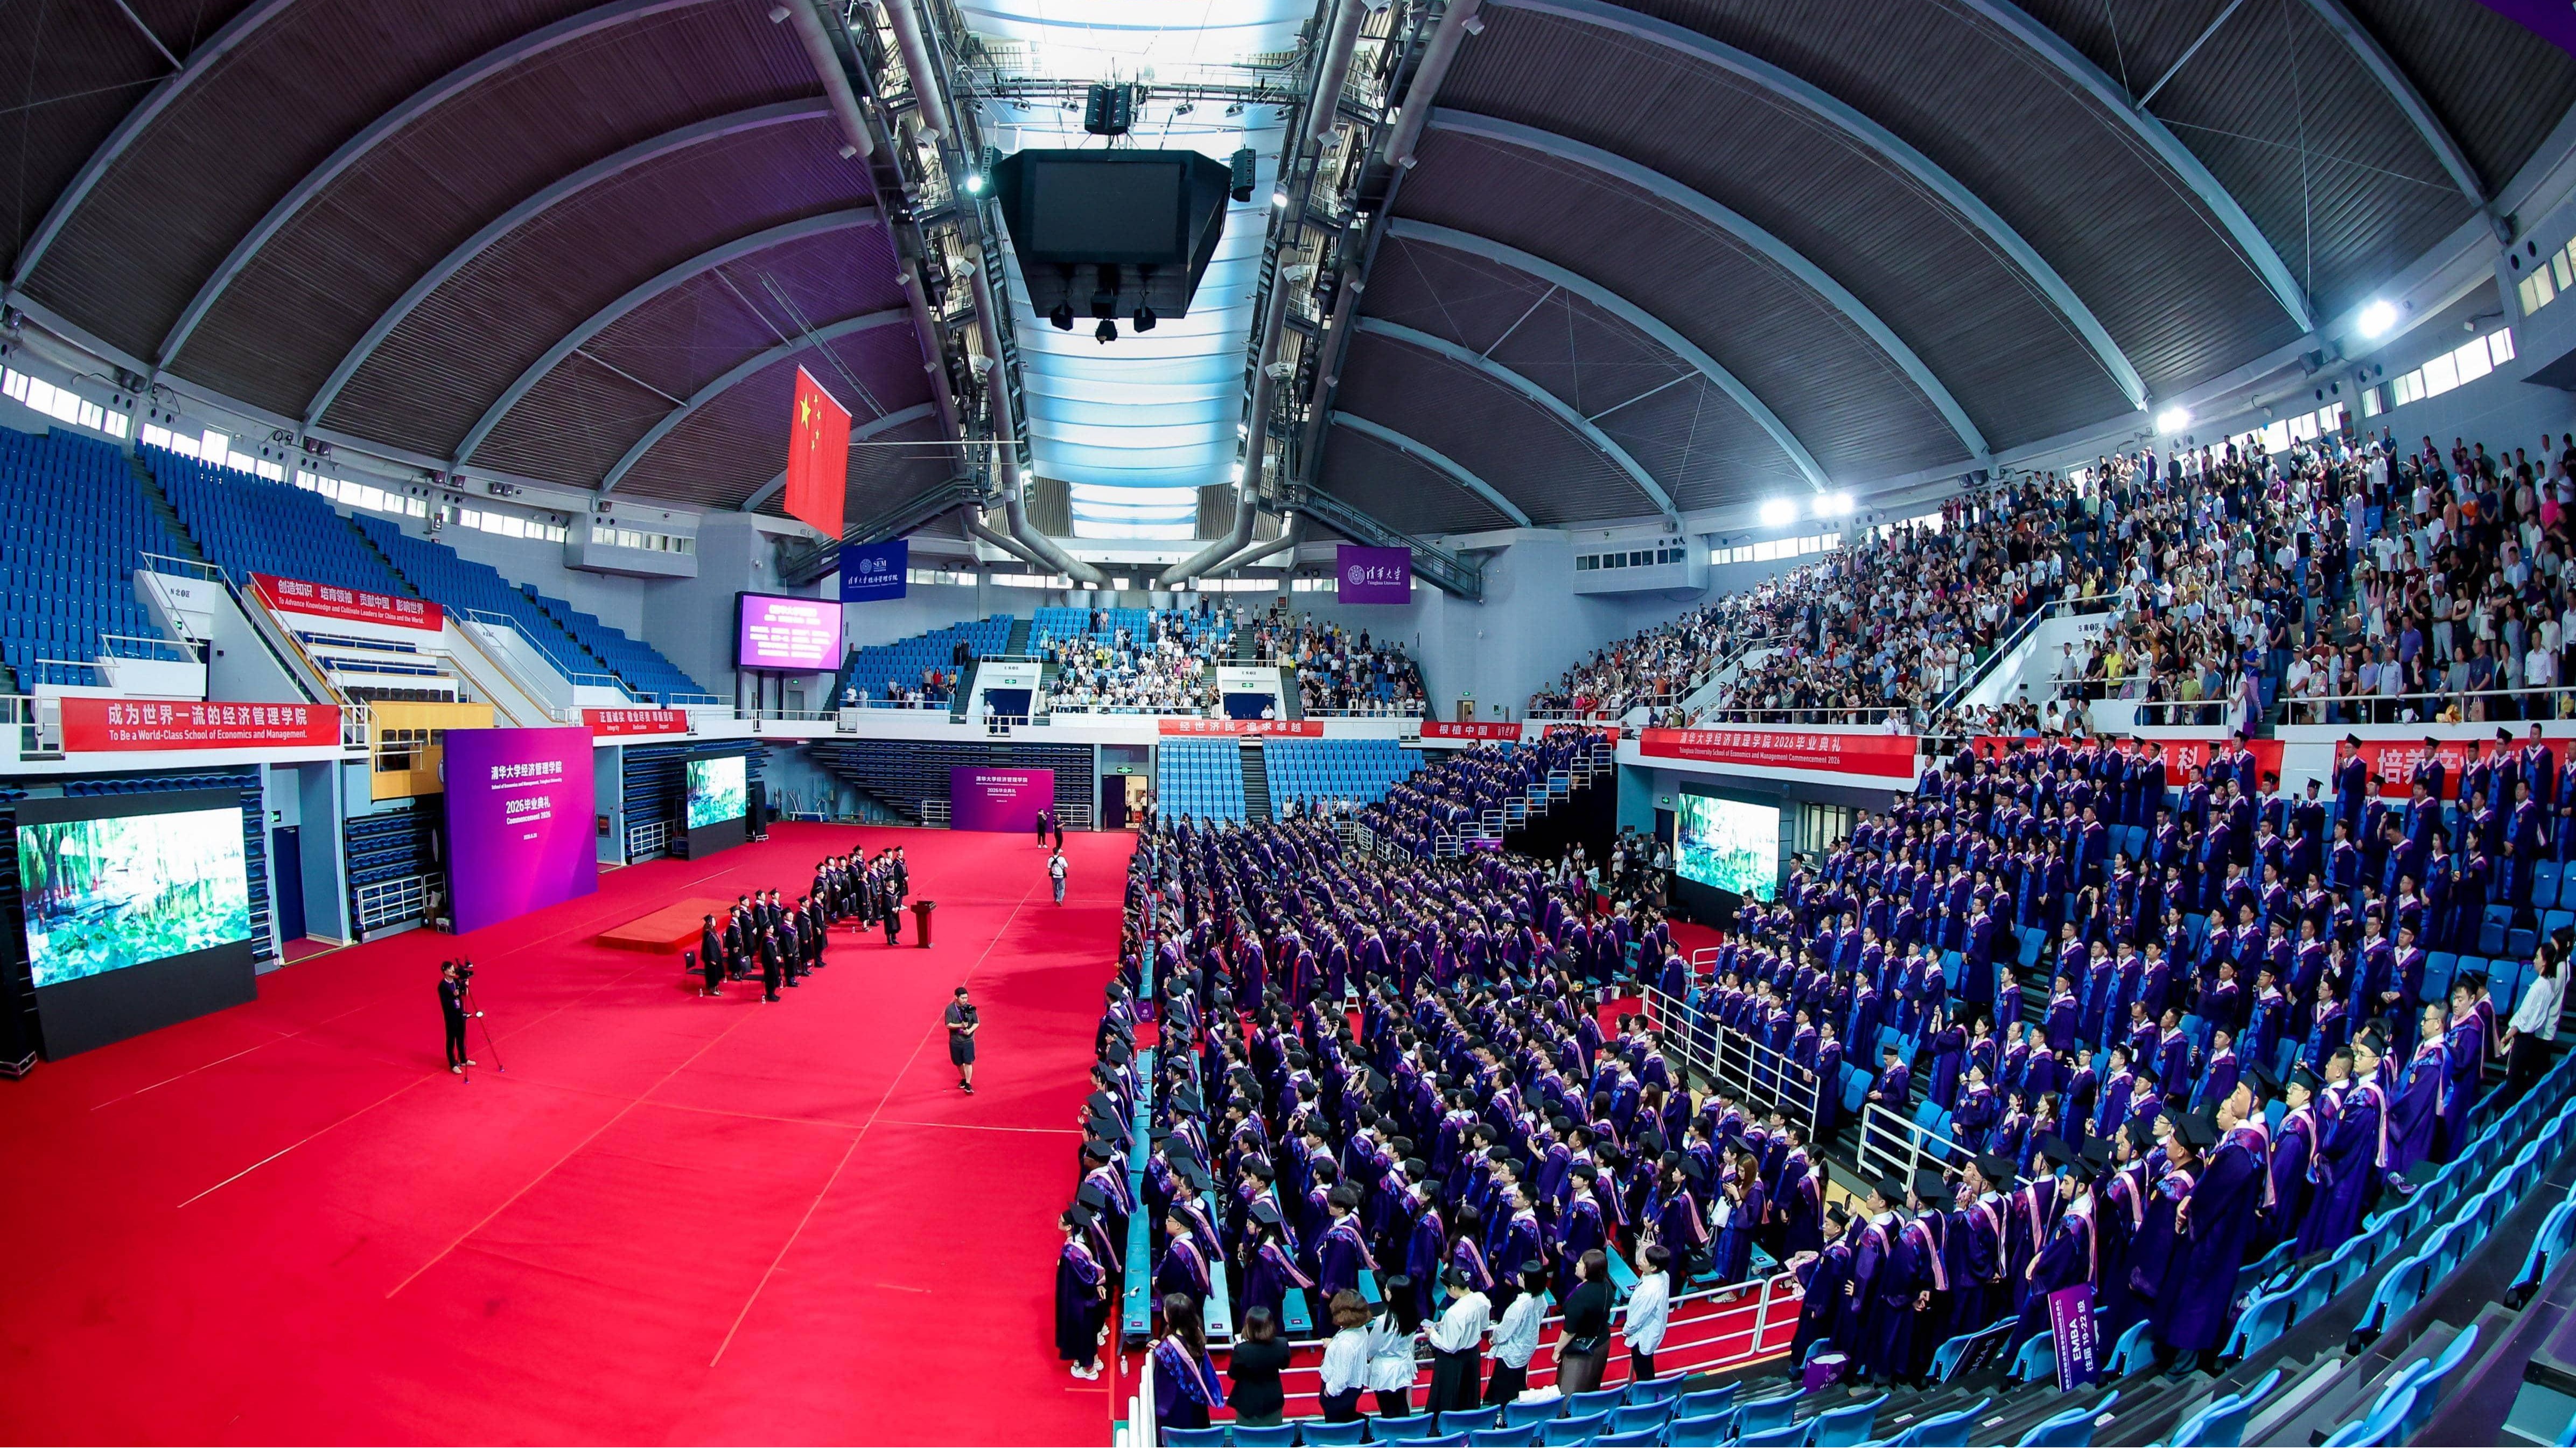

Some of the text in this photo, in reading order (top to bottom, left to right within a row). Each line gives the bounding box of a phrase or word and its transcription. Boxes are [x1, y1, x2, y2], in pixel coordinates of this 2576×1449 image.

[278, 579, 424, 615] 创造知识 培育领袖 贡献中国 影响世界
[278, 597, 284, 605] To
[285, 598, 305, 607] Advance
[305, 600, 331, 612] Knowledge
[332, 604, 340, 612] and
[340, 606, 360, 615] Cultivate
[361, 608, 377, 618] Leaders
[384, 612, 396, 620] China
[108, 703, 307, 726] 成为世界一流的经济管理学院
[599, 711, 625, 723] 正直诚实
[109, 729, 307, 740] To Be a World-Class School of Economics and Management.
[1179, 722, 1302, 733] 经世济民 追求卓越
[1439, 724, 1488, 736] 根植中国
[1679, 732, 1772, 748] 清华大学经济管理学院
[1679, 747, 1694, 755] Tsinghua
[1695, 747, 1712, 757] University
[1712, 748, 1725, 757] School
[1730, 750, 1751, 758] Economics
[1752, 751, 1760, 759] and
[1760, 751, 1788, 761] Management
[1789, 754, 1826, 764] Commencement
[1828, 756, 1840, 765] 2026
[491, 760, 562, 780] 清华大学经济管理学院
[506, 796, 550, 814] 2026毕业典礼
[507, 811, 551, 825] Commencement 2026
[2069, 1318, 2082, 1362] EMBA
